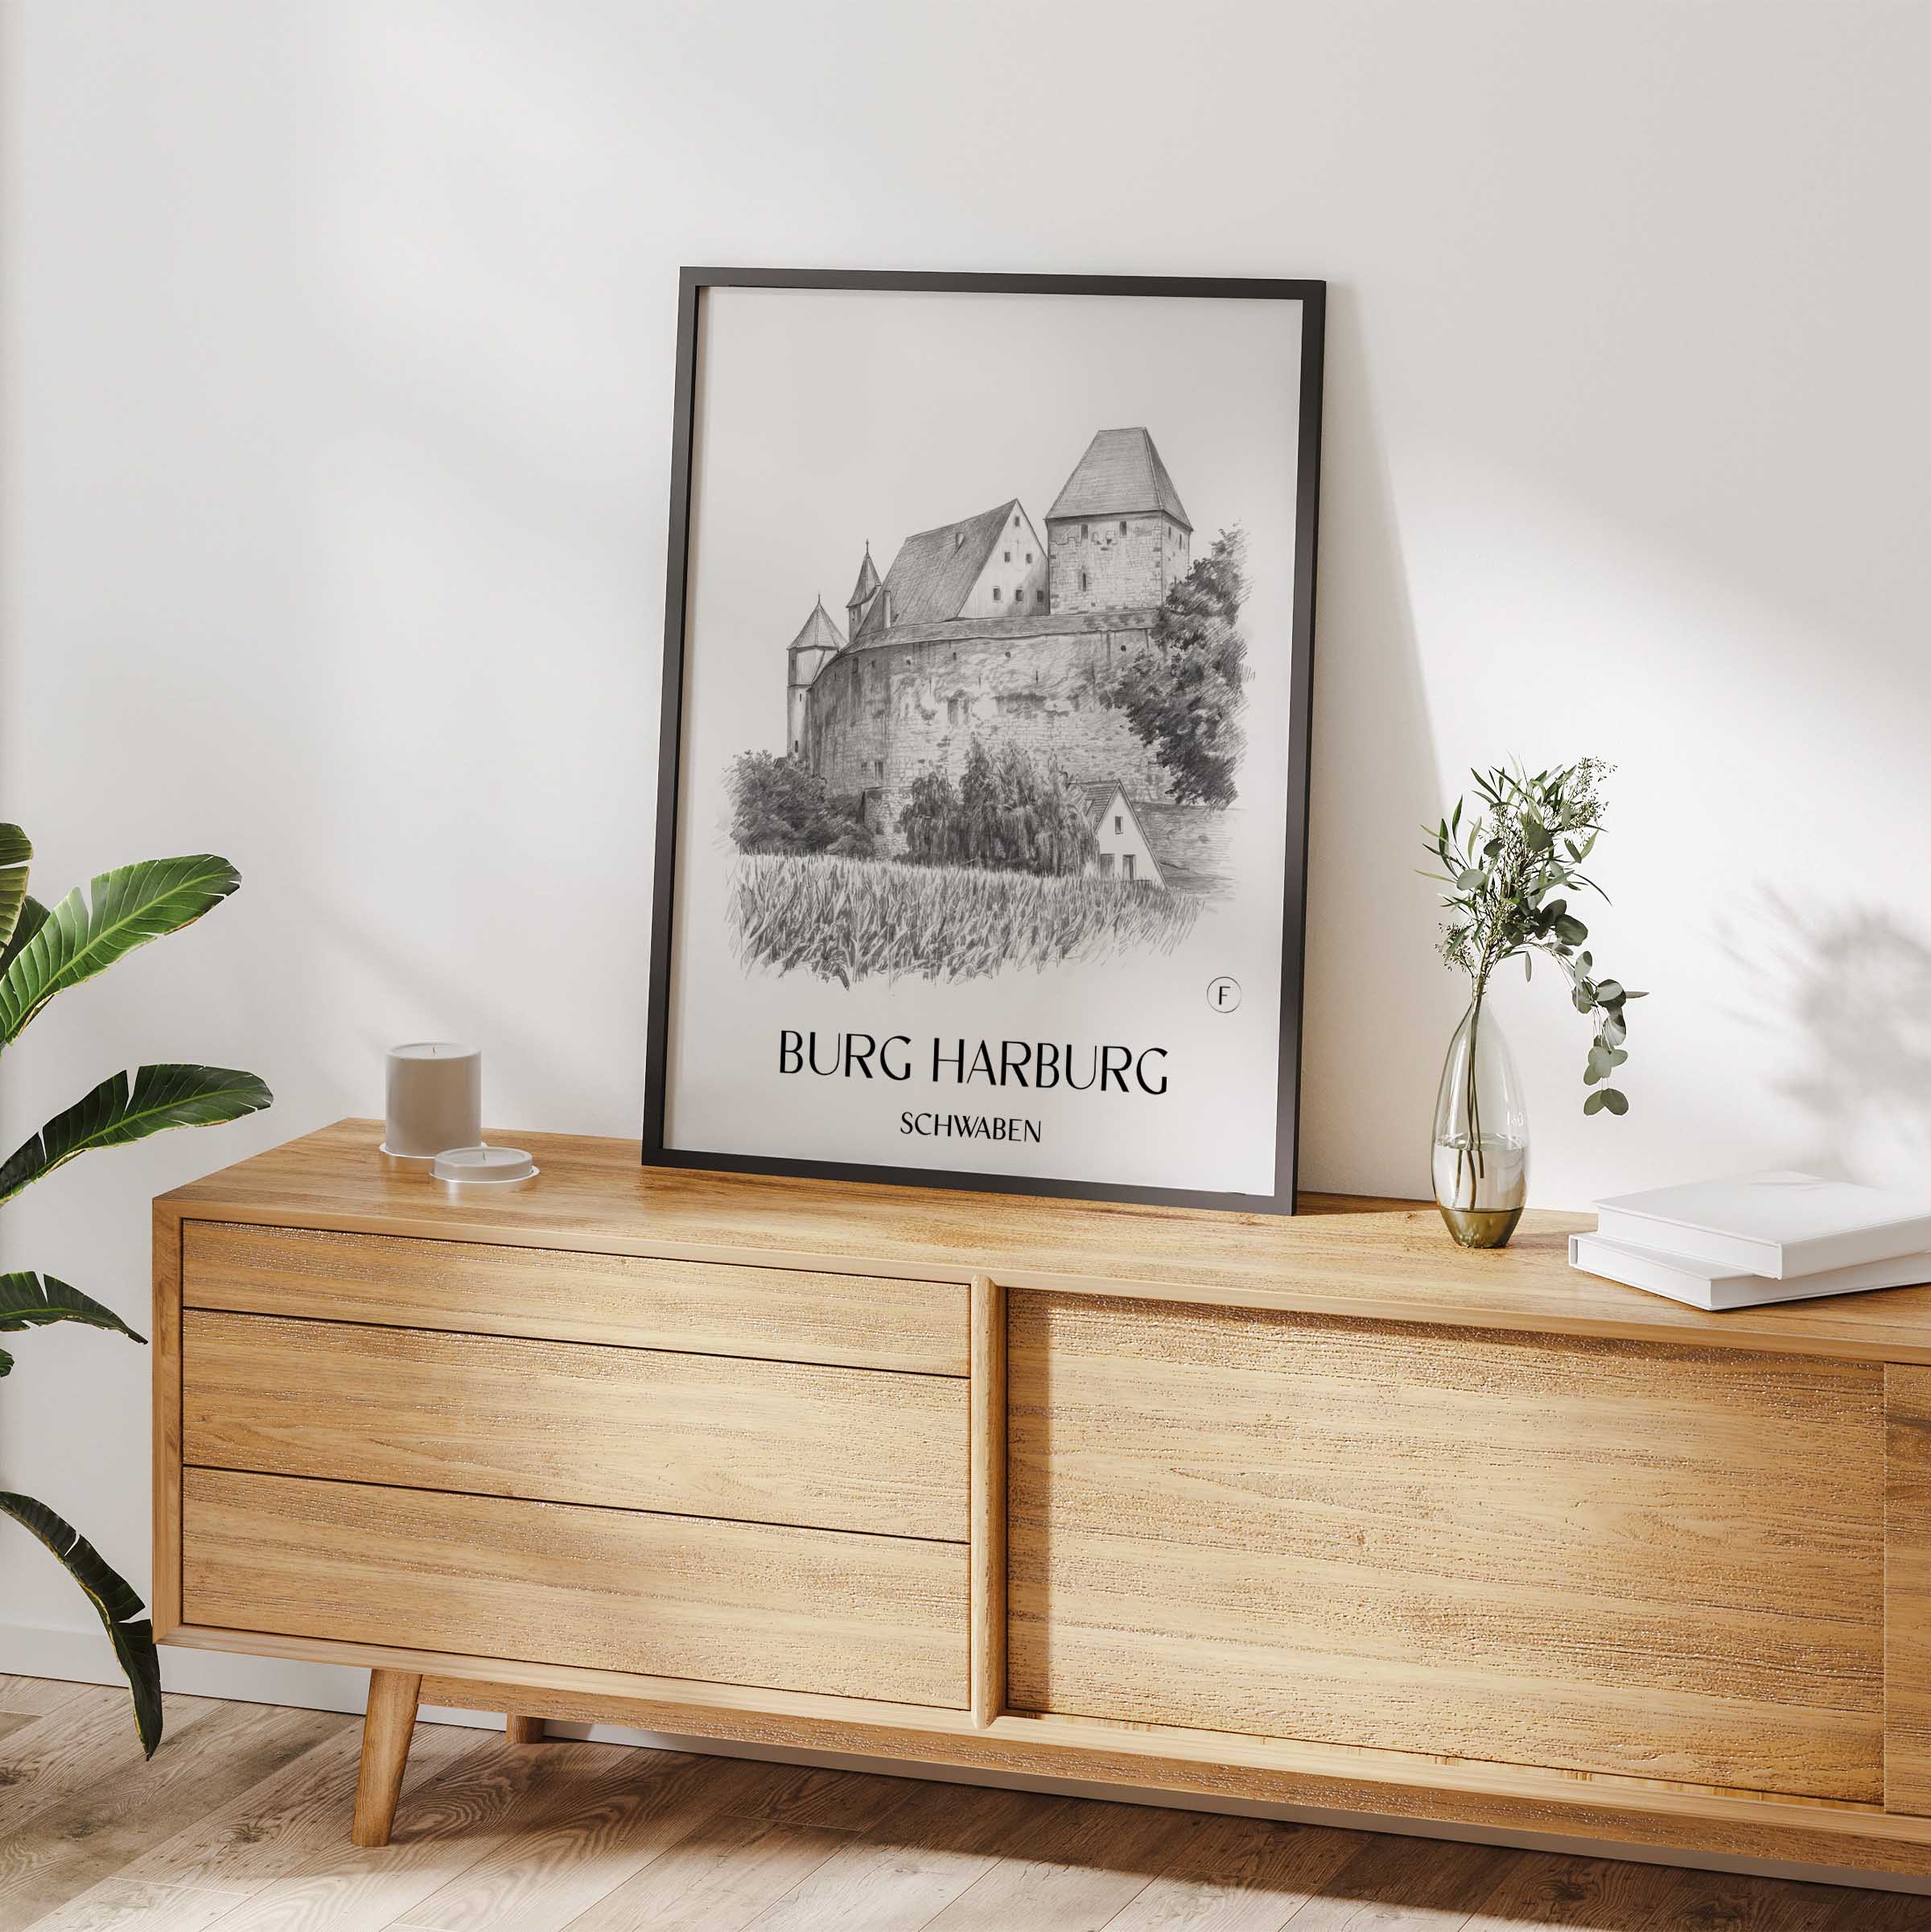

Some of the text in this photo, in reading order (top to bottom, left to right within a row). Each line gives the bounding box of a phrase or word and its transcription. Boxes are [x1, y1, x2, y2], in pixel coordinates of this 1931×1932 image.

[1217, 986, 1231, 1005] F
[779, 1029, 1168, 1095] BURG HARBURG
[900, 1111, 1042, 1143] SCHWABEN
